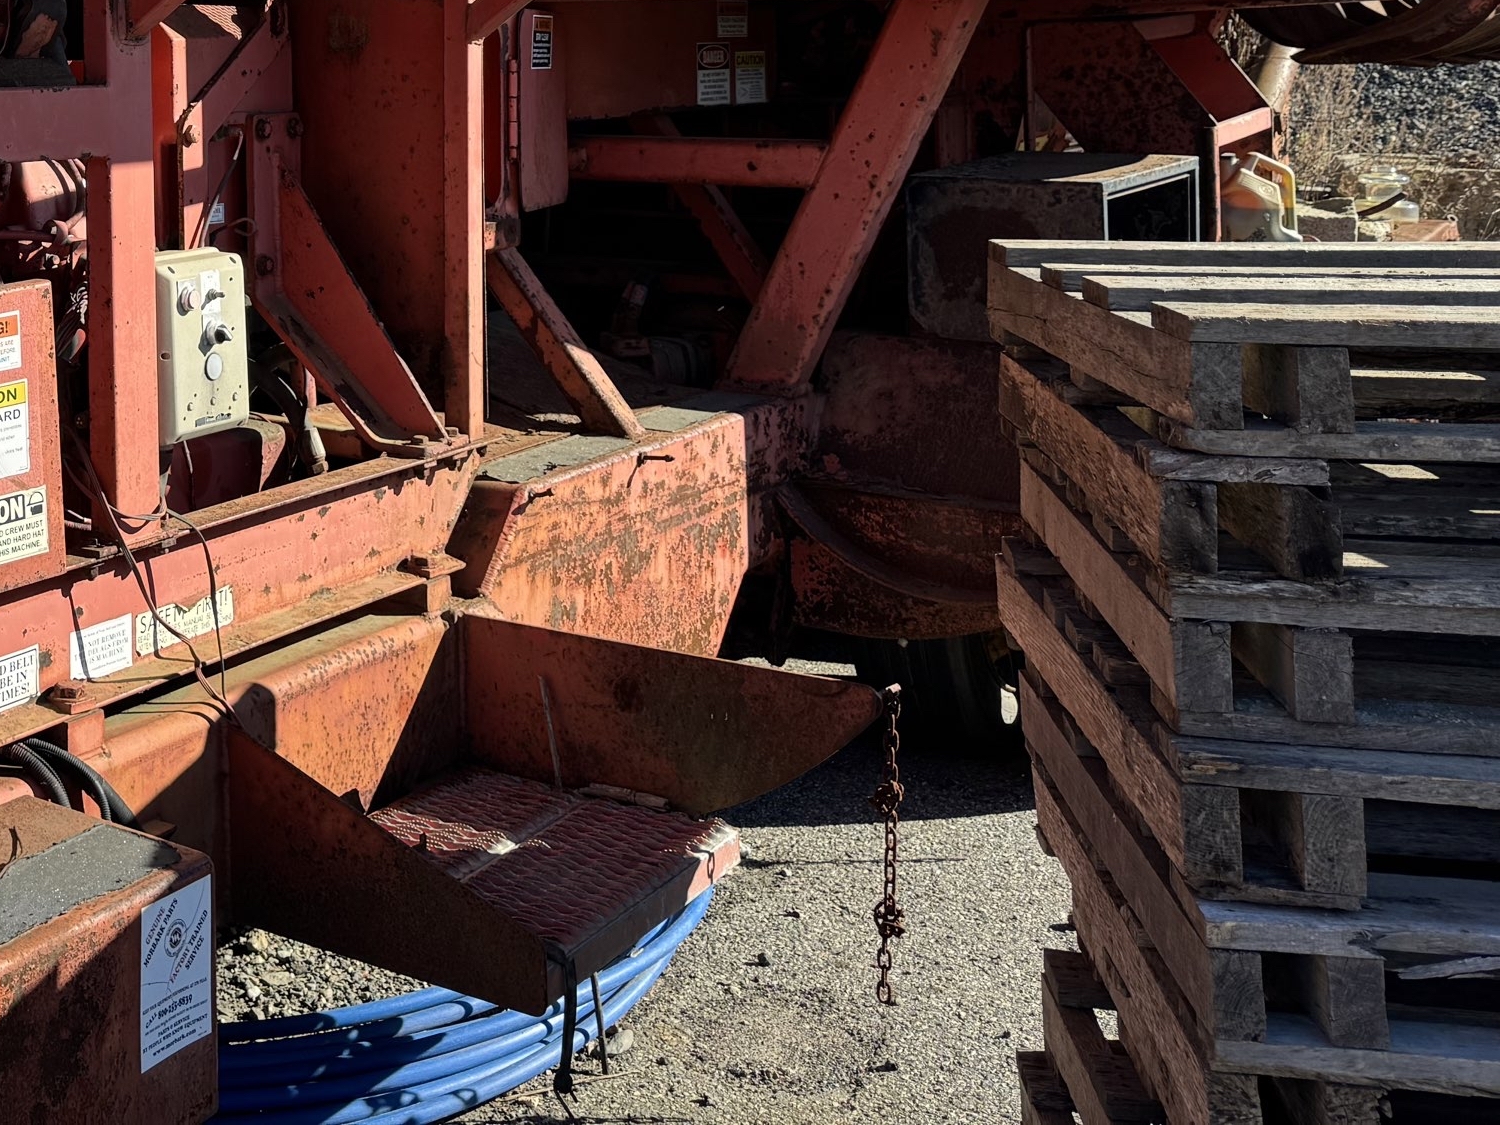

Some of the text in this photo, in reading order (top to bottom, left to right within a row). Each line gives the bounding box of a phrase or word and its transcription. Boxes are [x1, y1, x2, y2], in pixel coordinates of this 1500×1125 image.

[0, 355, 10, 363] UNIT
[4, 525, 24, 536] CREW
[25, 519, 43, 530] MUST
[12, 532, 32, 544] HARD
[32, 528, 45, 537] HAT
[196, 588, 228, 615] FIRT!
[9, 654, 35, 673] BELT
[0, 674, 14, 690] BE
[16, 669, 28, 684] IN
[143, 924, 166, 968] MORBARK
[163, 897, 178, 926] PARTS
[145, 906, 166, 945] GENUINE
[169, 946, 190, 984] FACTORY
[188, 909, 208, 946] TRAINED
[184, 935, 205, 970] SERVICE
